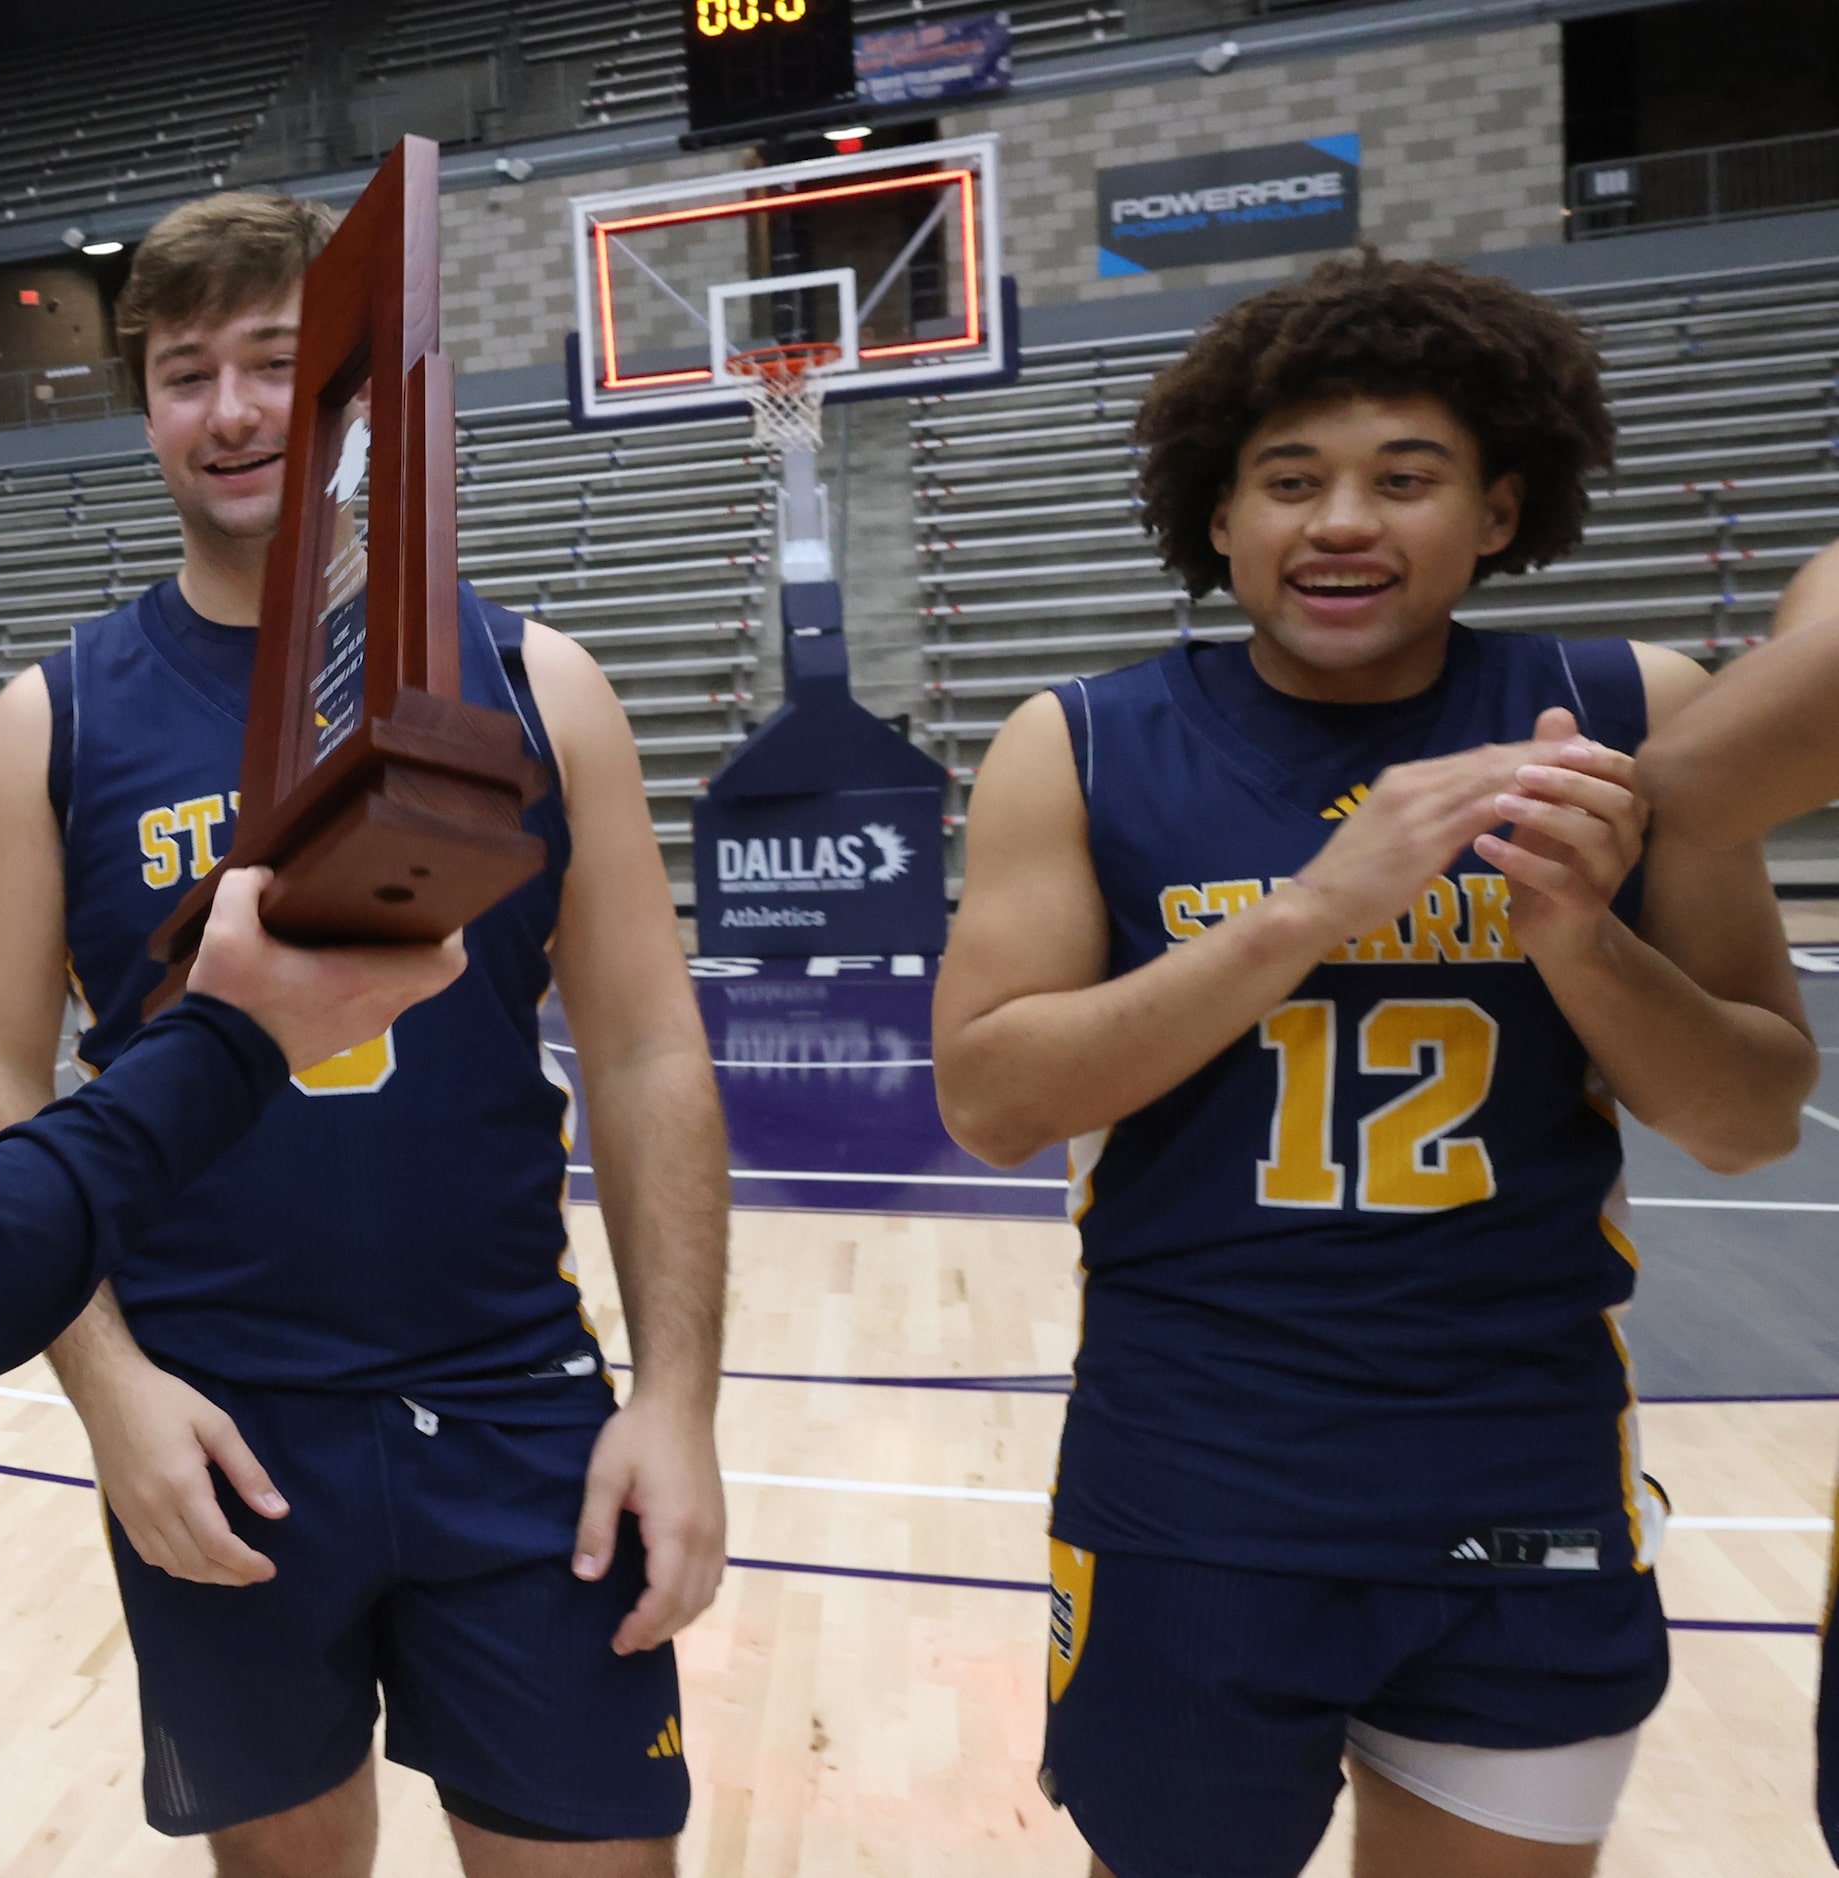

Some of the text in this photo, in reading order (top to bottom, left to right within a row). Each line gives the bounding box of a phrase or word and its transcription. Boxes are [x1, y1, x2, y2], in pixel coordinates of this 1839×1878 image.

[1112, 171, 1344, 224] POWERADE
[716, 834, 866, 881] DALLAS
[720, 906, 827, 928] Athletics
[1254, 998, 1500, 1214] 12
